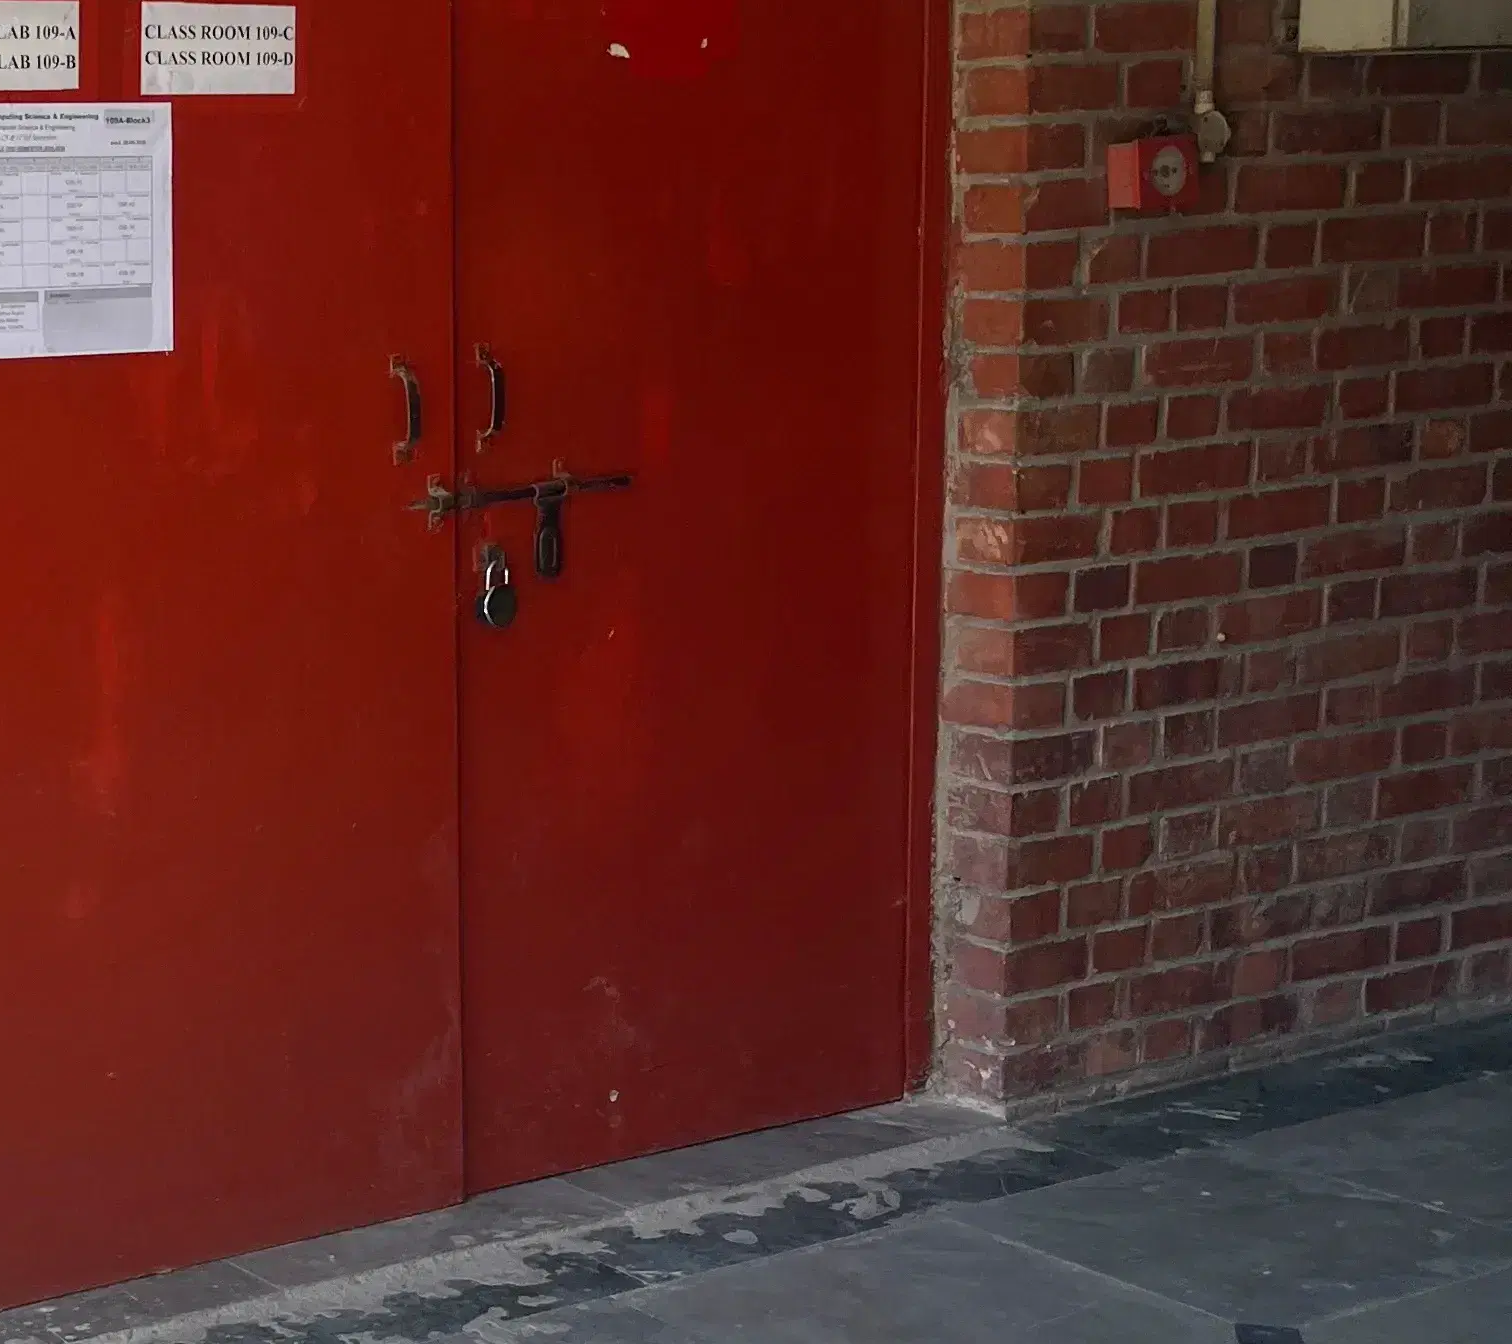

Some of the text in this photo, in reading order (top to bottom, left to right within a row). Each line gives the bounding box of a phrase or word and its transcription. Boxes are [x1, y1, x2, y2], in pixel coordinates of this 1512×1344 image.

[36, 25, 77, 41] 109-A
[144, 24, 294, 41] CLASS ROOM 109-C
[37, 54, 76, 70] 109-B
[145, 50, 294, 66] CLASS ROOM 109-D
